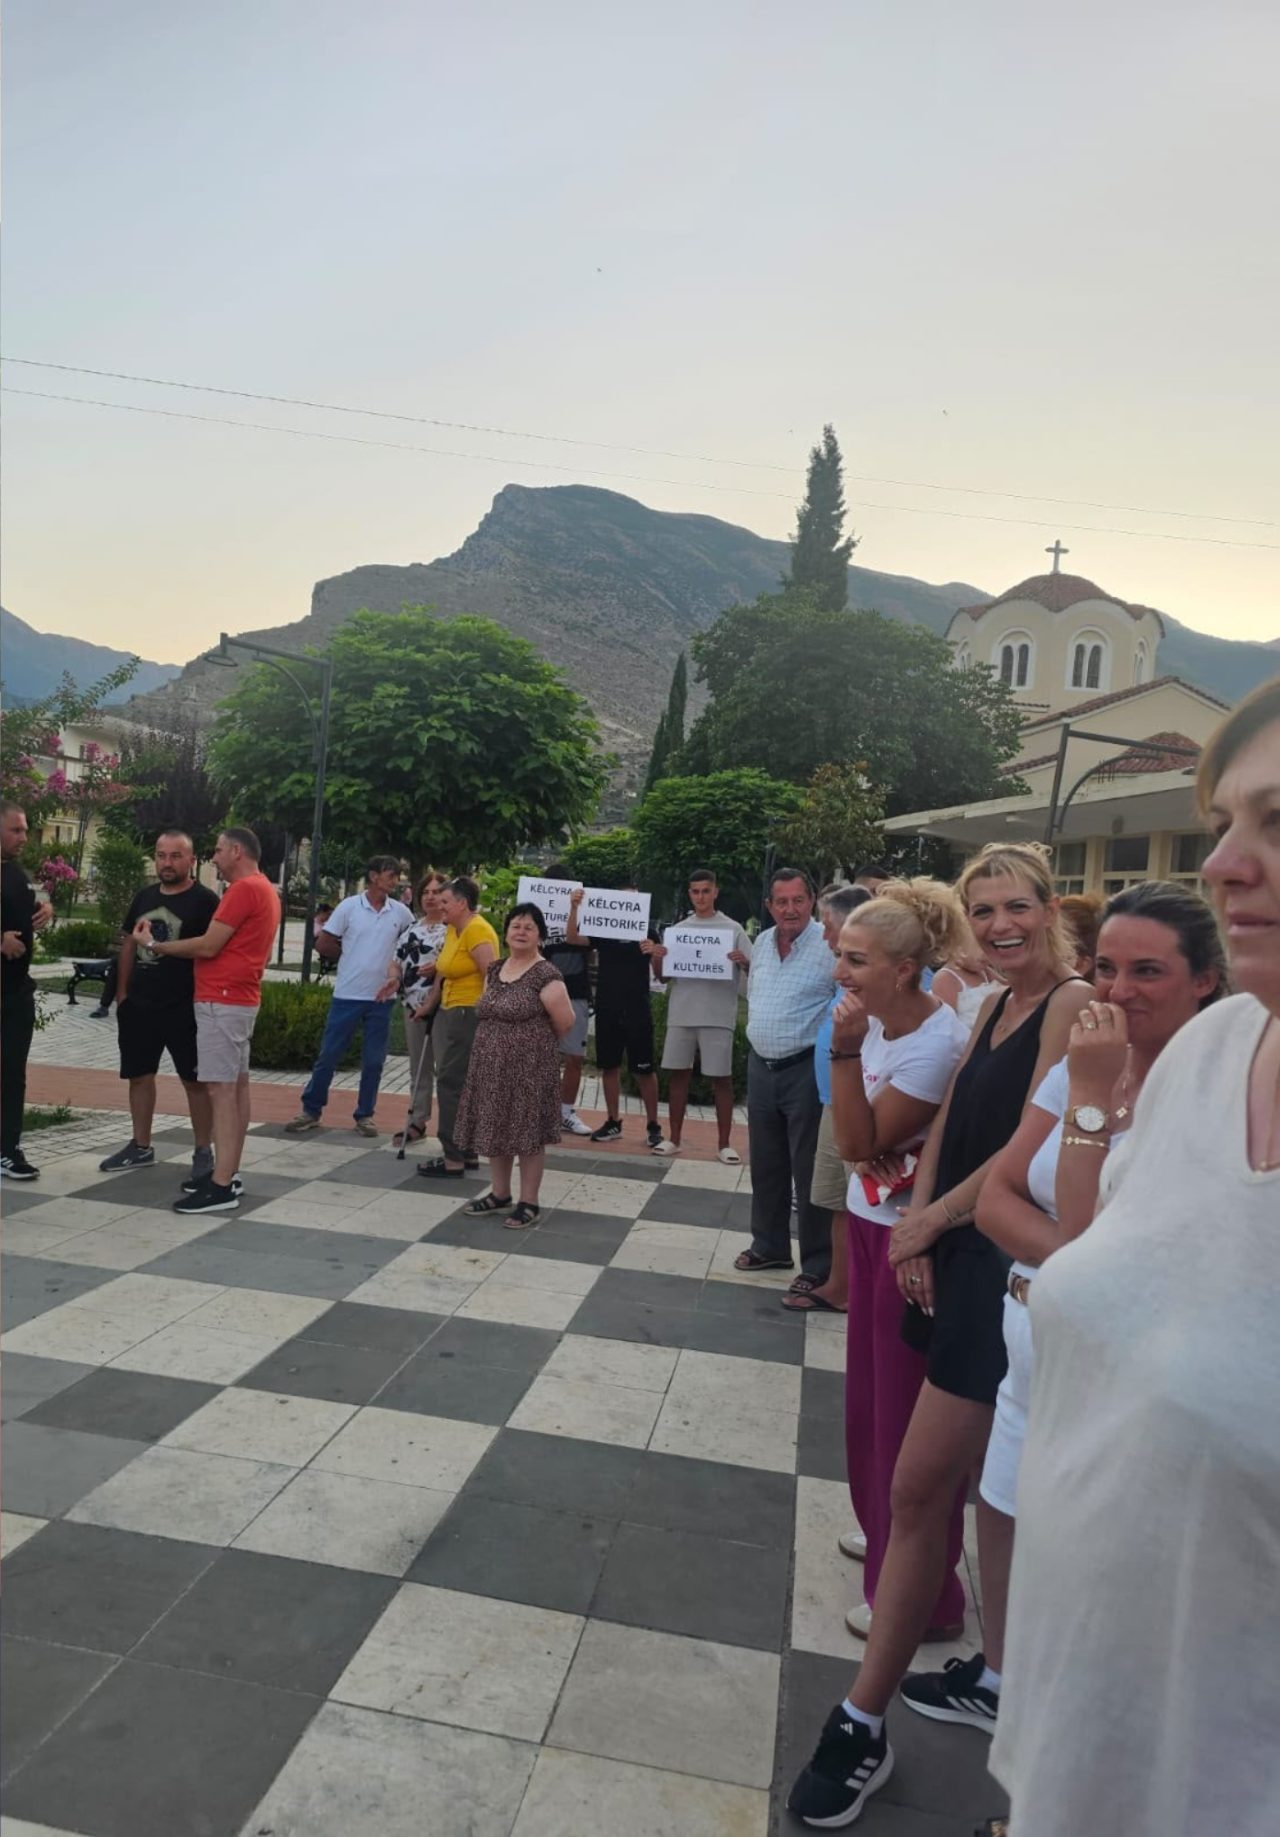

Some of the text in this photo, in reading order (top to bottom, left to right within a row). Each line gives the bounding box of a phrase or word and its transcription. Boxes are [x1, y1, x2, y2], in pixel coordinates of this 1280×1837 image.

[548, 899, 556, 909] E
[588, 896, 641, 912] KËLCYRA
[583, 915, 648, 931] HISTORIKE
[675, 934, 721, 945] KËLCYRA
[696, 949, 703, 959] E
[673, 961, 725, 974] KULTURËS
